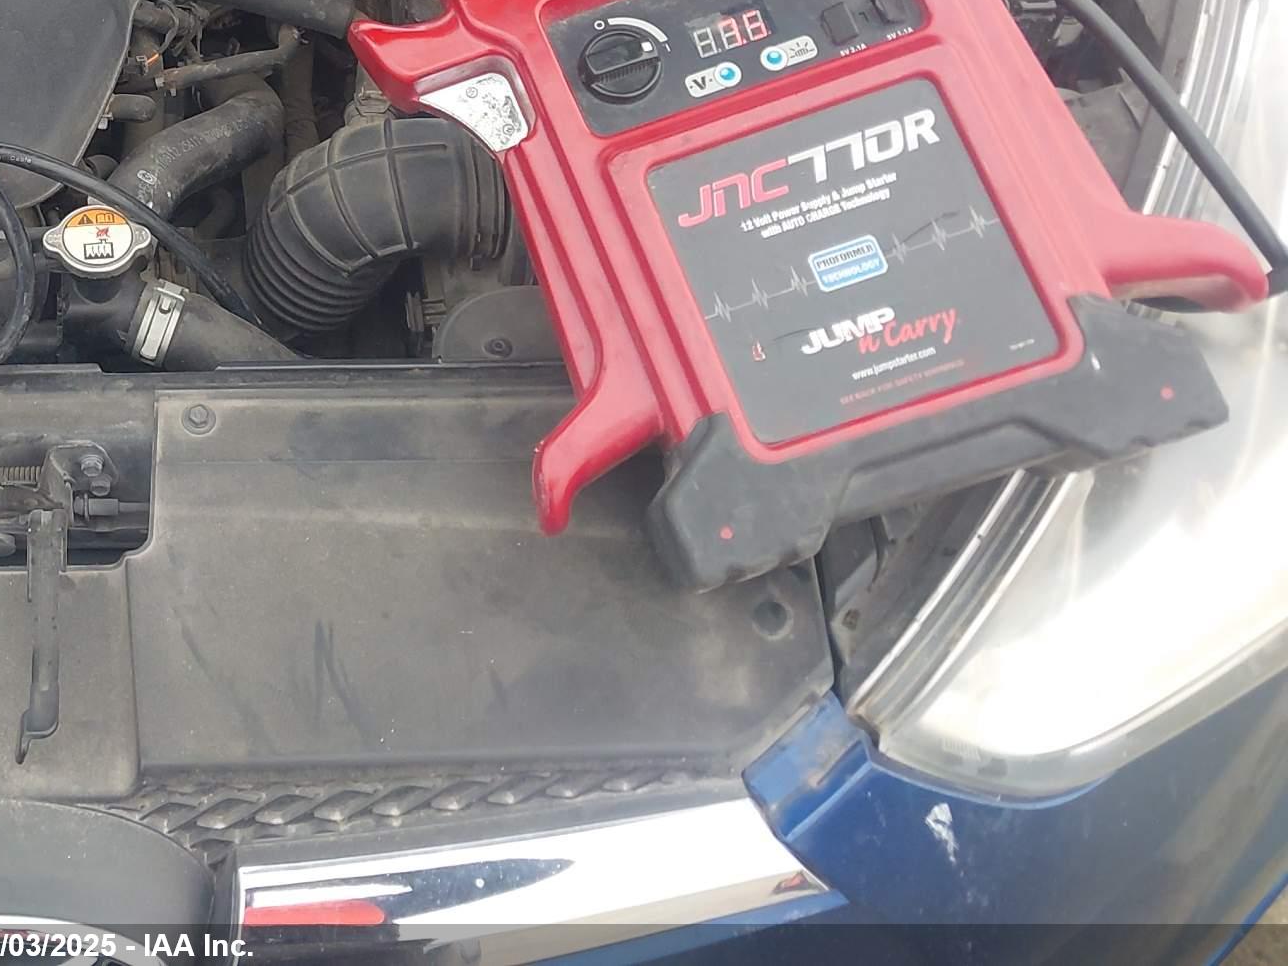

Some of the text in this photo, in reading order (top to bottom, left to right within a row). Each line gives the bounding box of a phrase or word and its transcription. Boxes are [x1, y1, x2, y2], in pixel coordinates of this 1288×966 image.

[740, 172, 897, 232] 12 Volt Power Supply & Jump Starter
[761, 224, 783, 239] with
[781, 215, 806, 232] AUTO
[841, 188, 891, 211] Technology
[800, 306, 896, 355] JUMP
[883, 307, 957, 347] Carry
[852, 346, 937, 380] www.jumpstarter.com
